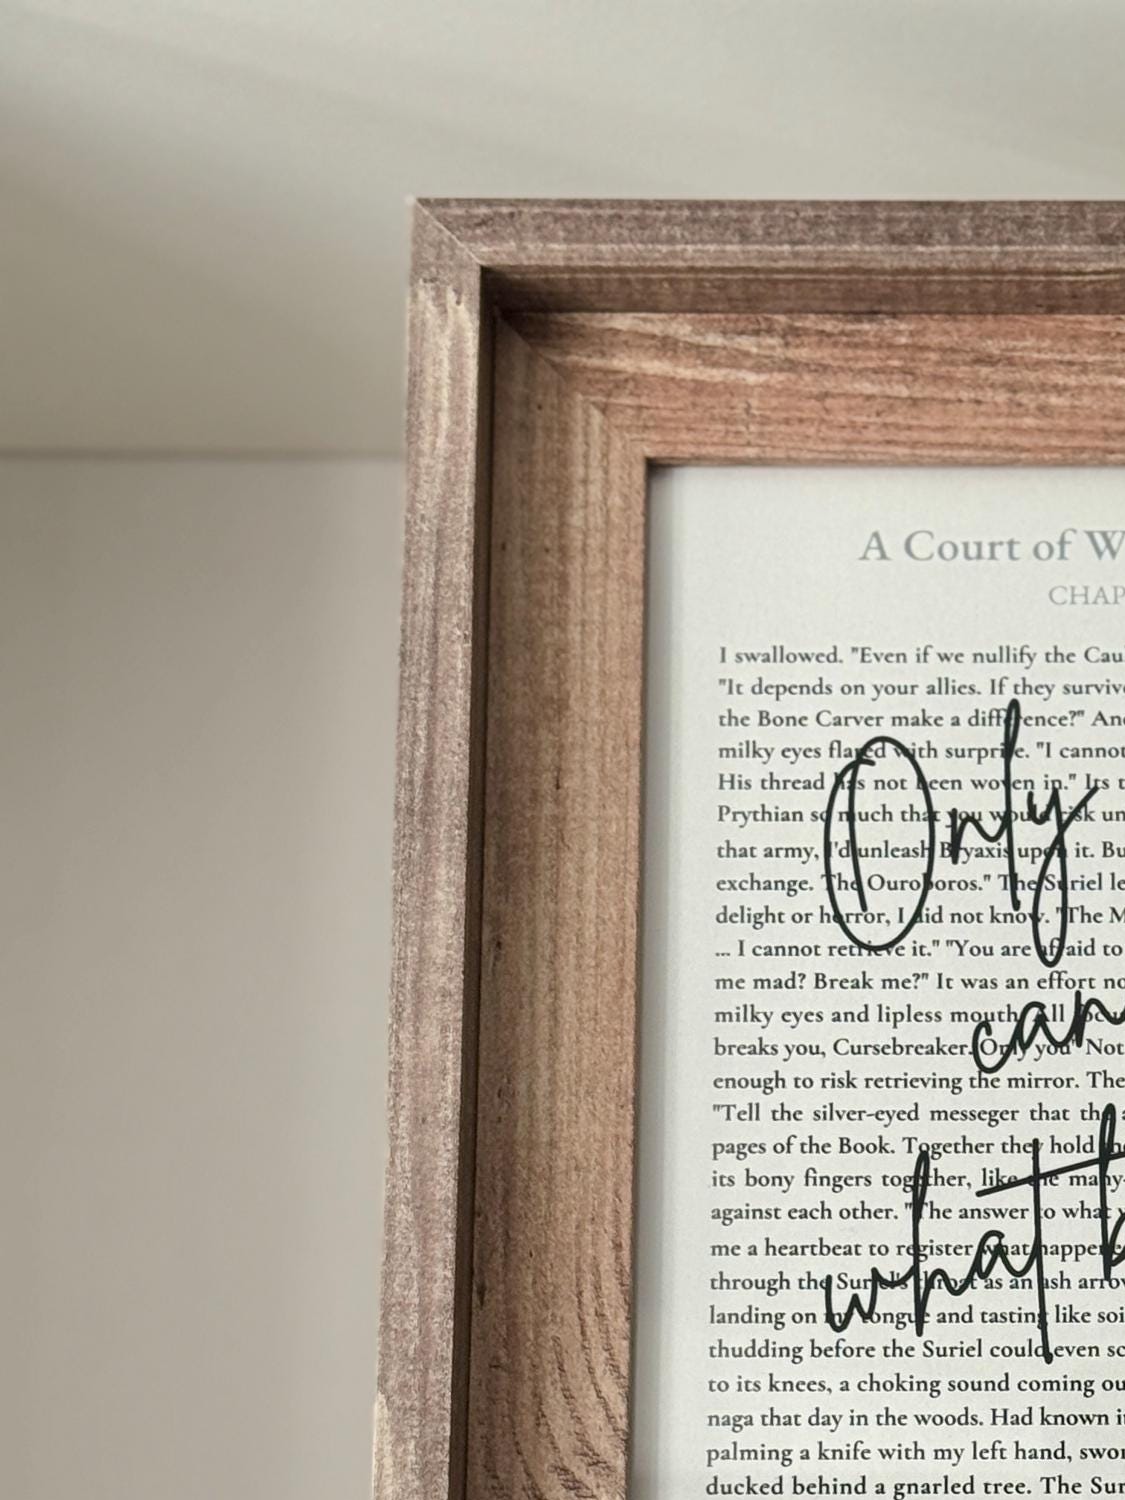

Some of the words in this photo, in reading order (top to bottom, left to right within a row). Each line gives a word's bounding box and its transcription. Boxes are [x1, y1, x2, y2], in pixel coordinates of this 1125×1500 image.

[858, 530, 892, 561] A
[903, 529, 1021, 562] Court
[1032, 527, 1078, 562] of
[720, 646, 726, 664] I
[734, 644, 844, 664] swallowed.
[850, 646, 908, 664] "Even
[915, 644, 934, 664] if
[936, 652, 965, 664] we
[972, 644, 1037, 670] nullify
[1044, 644, 1076, 664] the
[718, 678, 743, 696] "It
[750, 676, 833, 702] depends
[839, 683, 866, 696] on
[871, 683, 919, 702] your
[925, 676, 982, 696] allies.
[990, 676, 1010, 696] If
[1012, 675, 1056, 702] they
[824, 698, 1100, 967] Only
[712, 1069, 787, 1096] enough
[793, 1076, 815, 1090] to
[820, 1069, 858, 1089] risk
[863, 1071, 963, 1096] retrieving
[968, 1069, 1002, 1089] the
[1006, 1071, 1080, 1089] mirror.
[1085, 1068, 1125, 1089] The
[712, 1101, 761, 1122] "Tell
[770, 1101, 804, 1122] the
[812, 1101, 920, 1129] silver-eyed
[929, 1109, 1020, 1129] messeger
[1029, 1101, 1071, 1122] that
[708, 1379, 730, 1393] to
[736, 1374, 762, 1393] its
[767, 1372, 833, 1395] knees,
[839, 1380, 851, 1392] a
[856, 1371, 942, 1399] choking
[947, 1371, 1011, 1393] sound
[1016, 1374, 1096, 1399] coming
